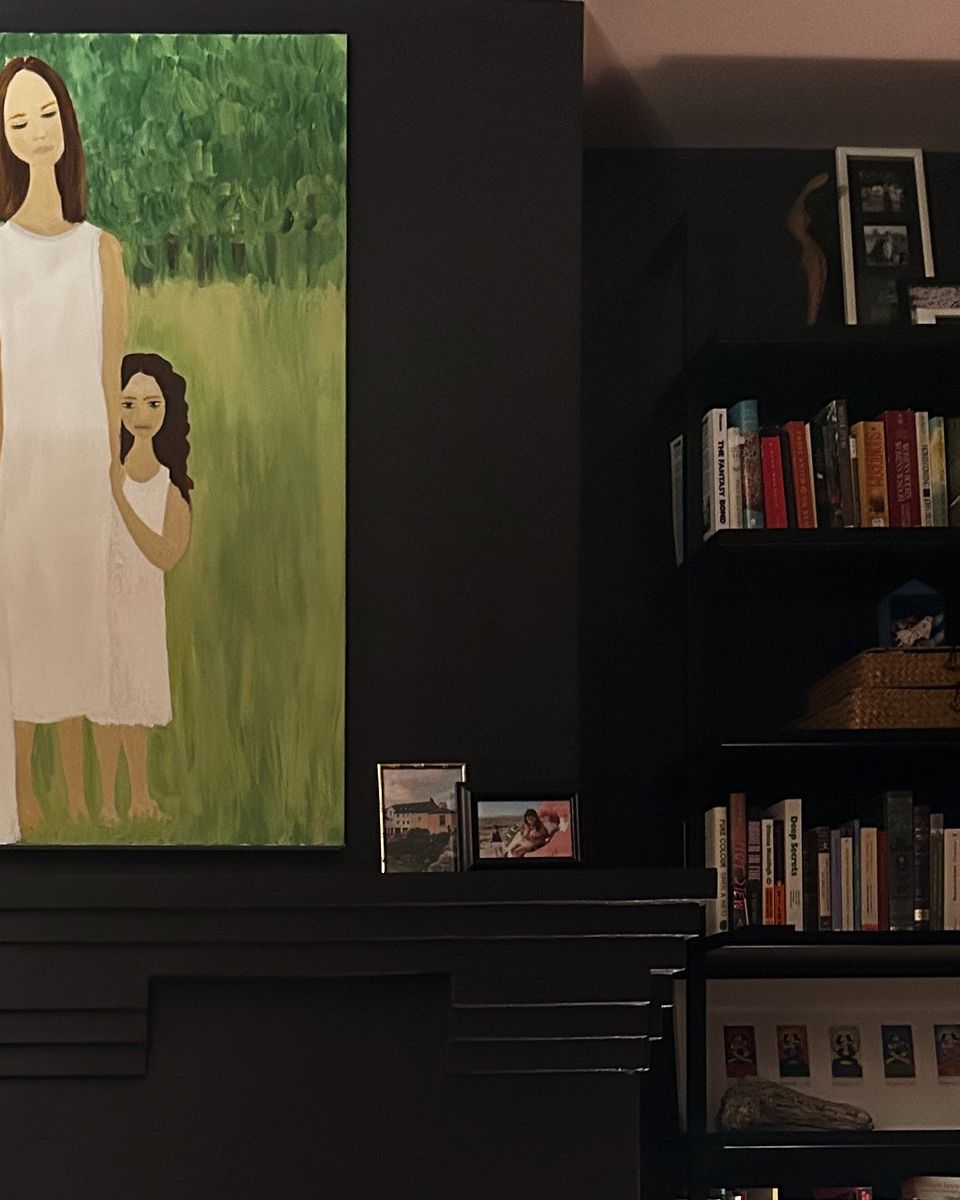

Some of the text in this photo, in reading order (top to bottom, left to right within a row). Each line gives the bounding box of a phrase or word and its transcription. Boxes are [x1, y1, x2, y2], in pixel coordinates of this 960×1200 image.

[718, 459, 726, 497] FANTASY
[719, 838, 727, 868] COLOUR
[788, 816, 799, 876] Deep Secrets
